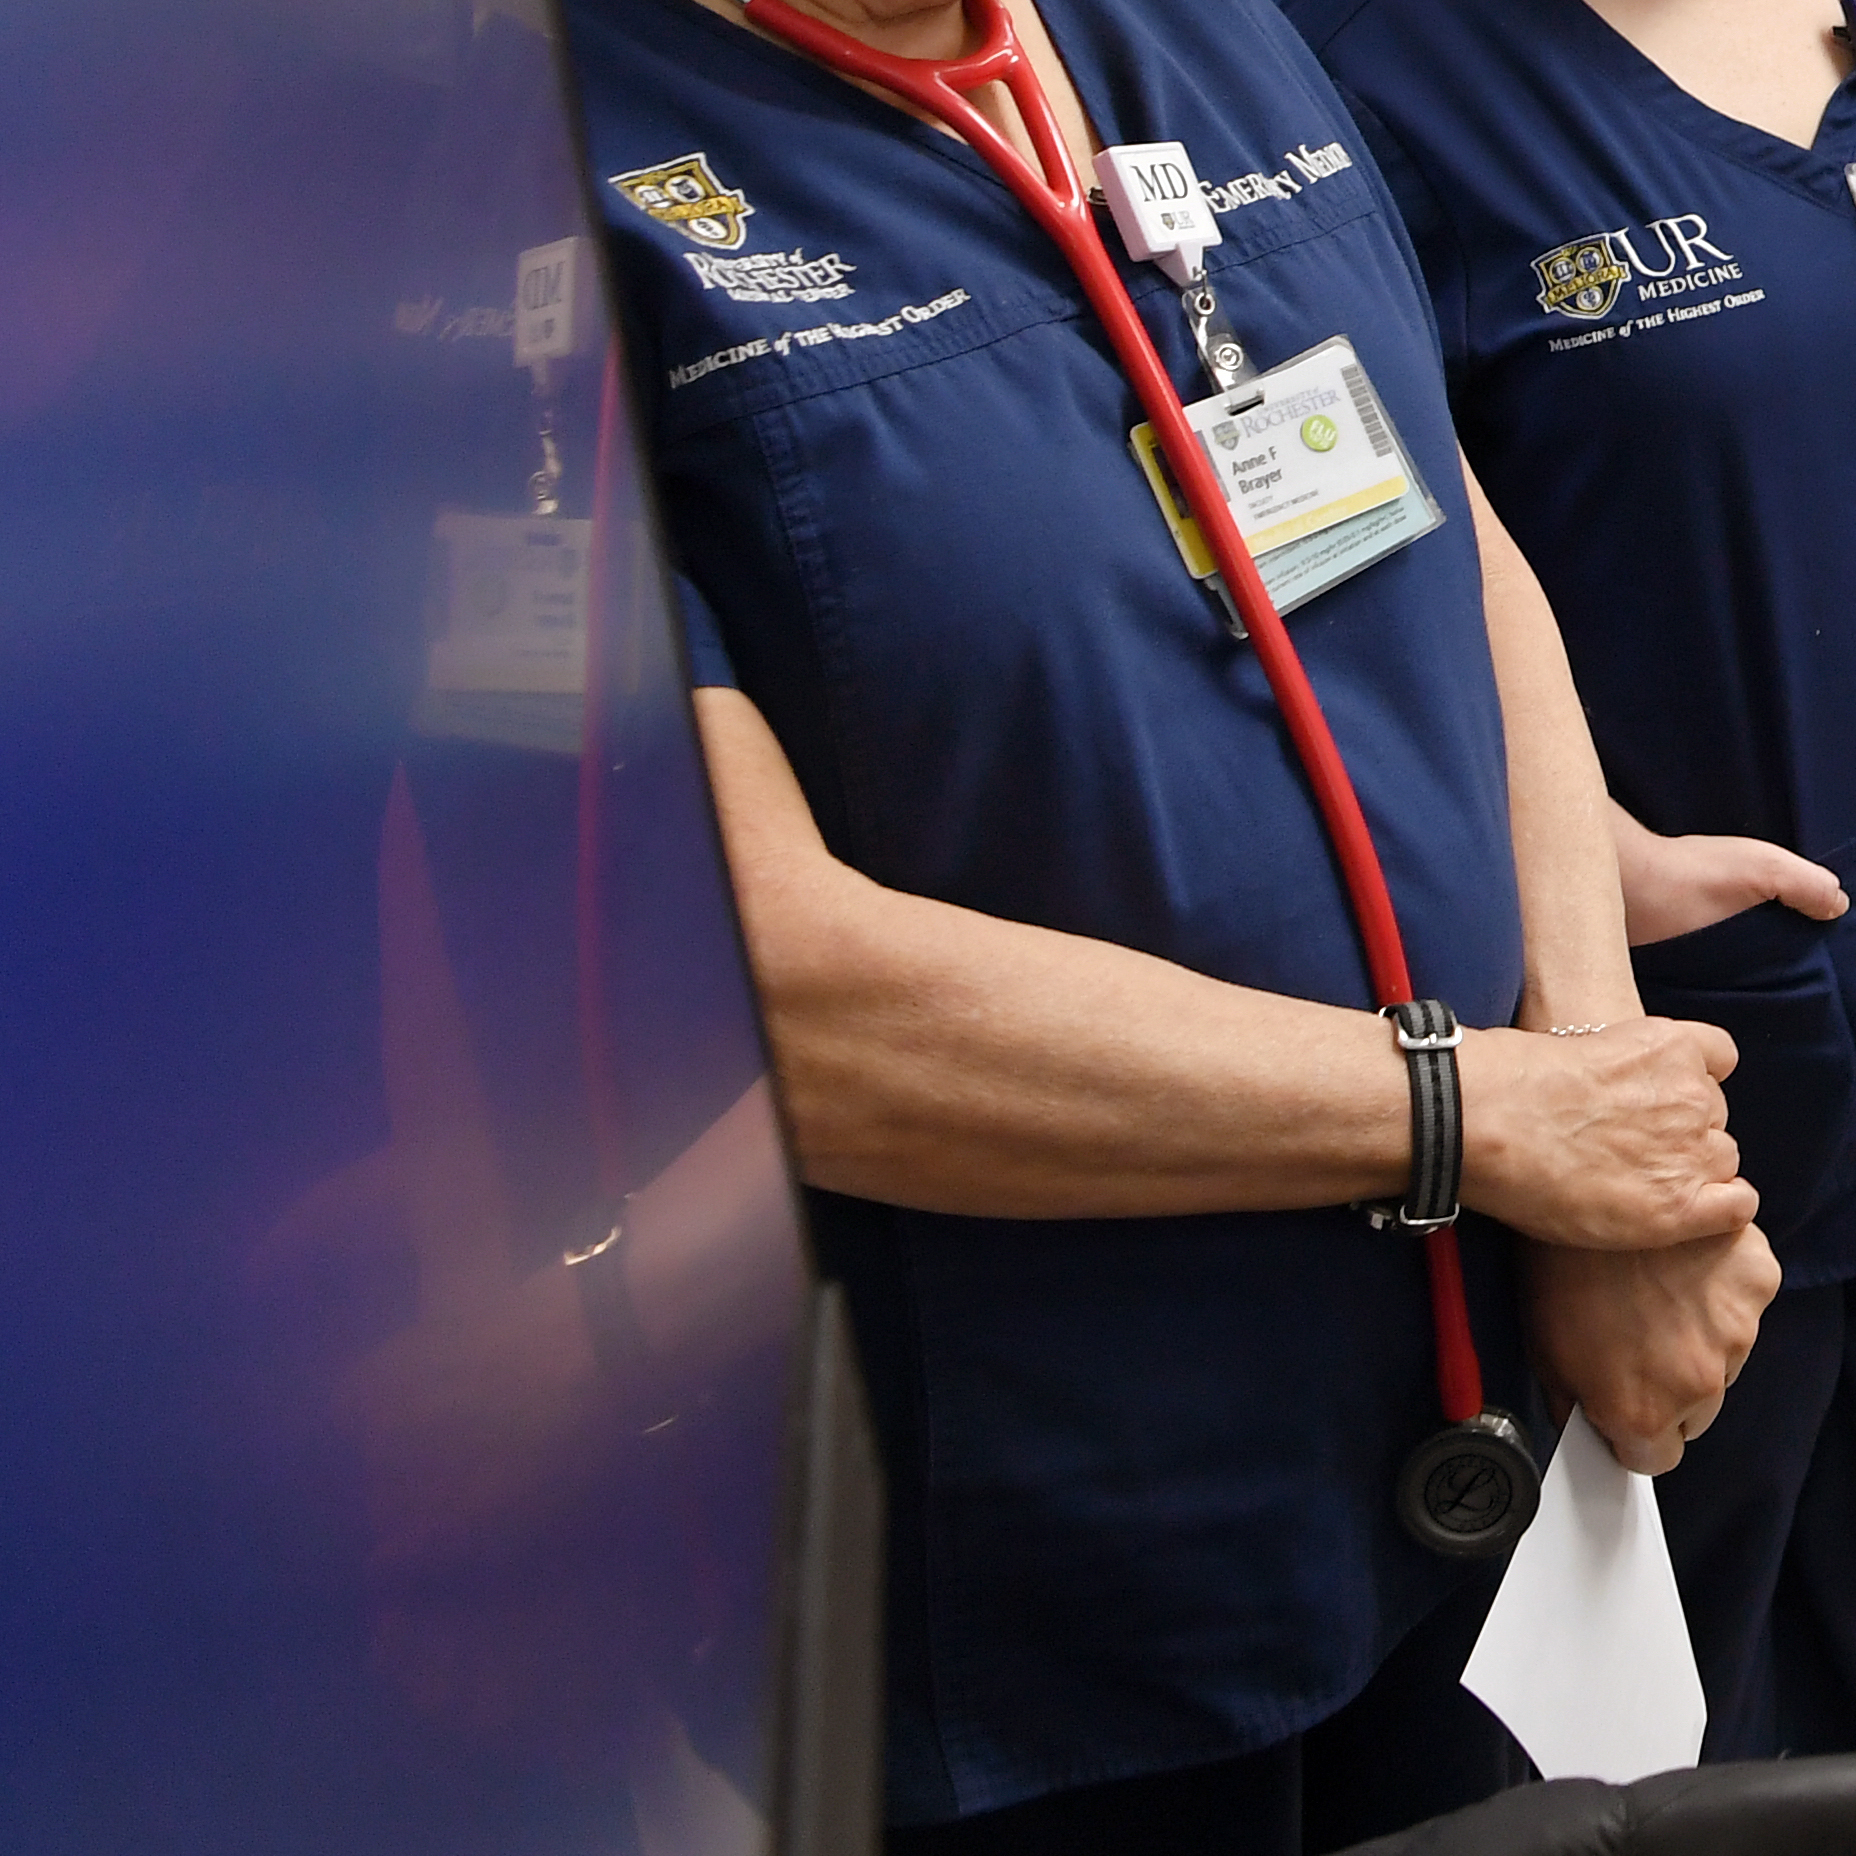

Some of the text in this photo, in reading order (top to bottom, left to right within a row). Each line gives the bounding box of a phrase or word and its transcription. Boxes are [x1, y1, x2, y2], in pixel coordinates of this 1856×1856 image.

[1131, 162, 1189, 202] MD
[1607, 213, 1734, 277] UR
[1638, 262, 1743, 301] MEDICINE
[669, 338, 772, 389] MEDICINE
[772, 332, 793, 356] of
[793, 325, 834, 347] THE
[900, 288, 972, 323] ORDER
[1548, 289, 1766, 353] MEDICINE of THE HIGHEST ORDER
[1240, 389, 1341, 438] ROCHESTER
[1232, 446, 1278, 476] Anne F
[1238, 468, 1283, 495] Brayer
